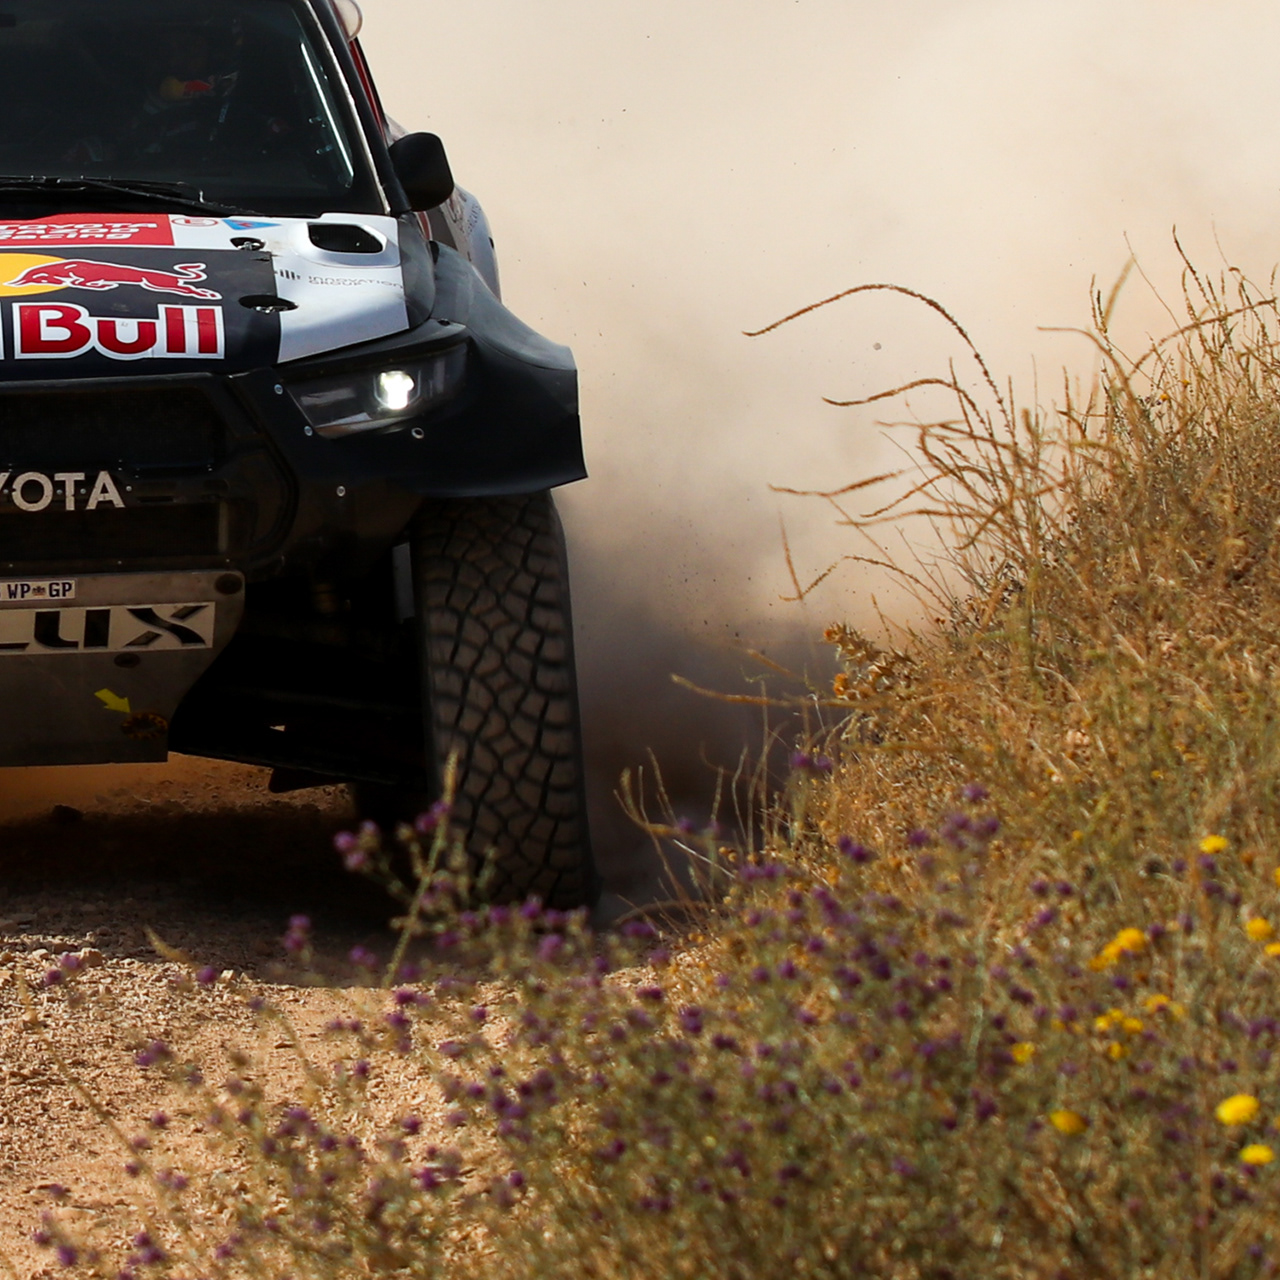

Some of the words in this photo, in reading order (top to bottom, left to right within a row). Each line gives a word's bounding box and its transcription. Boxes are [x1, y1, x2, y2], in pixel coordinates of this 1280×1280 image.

[18, 305, 220, 356] Bull
[7, 583, 31, 599] WP
[48, 581, 72, 598] GP
